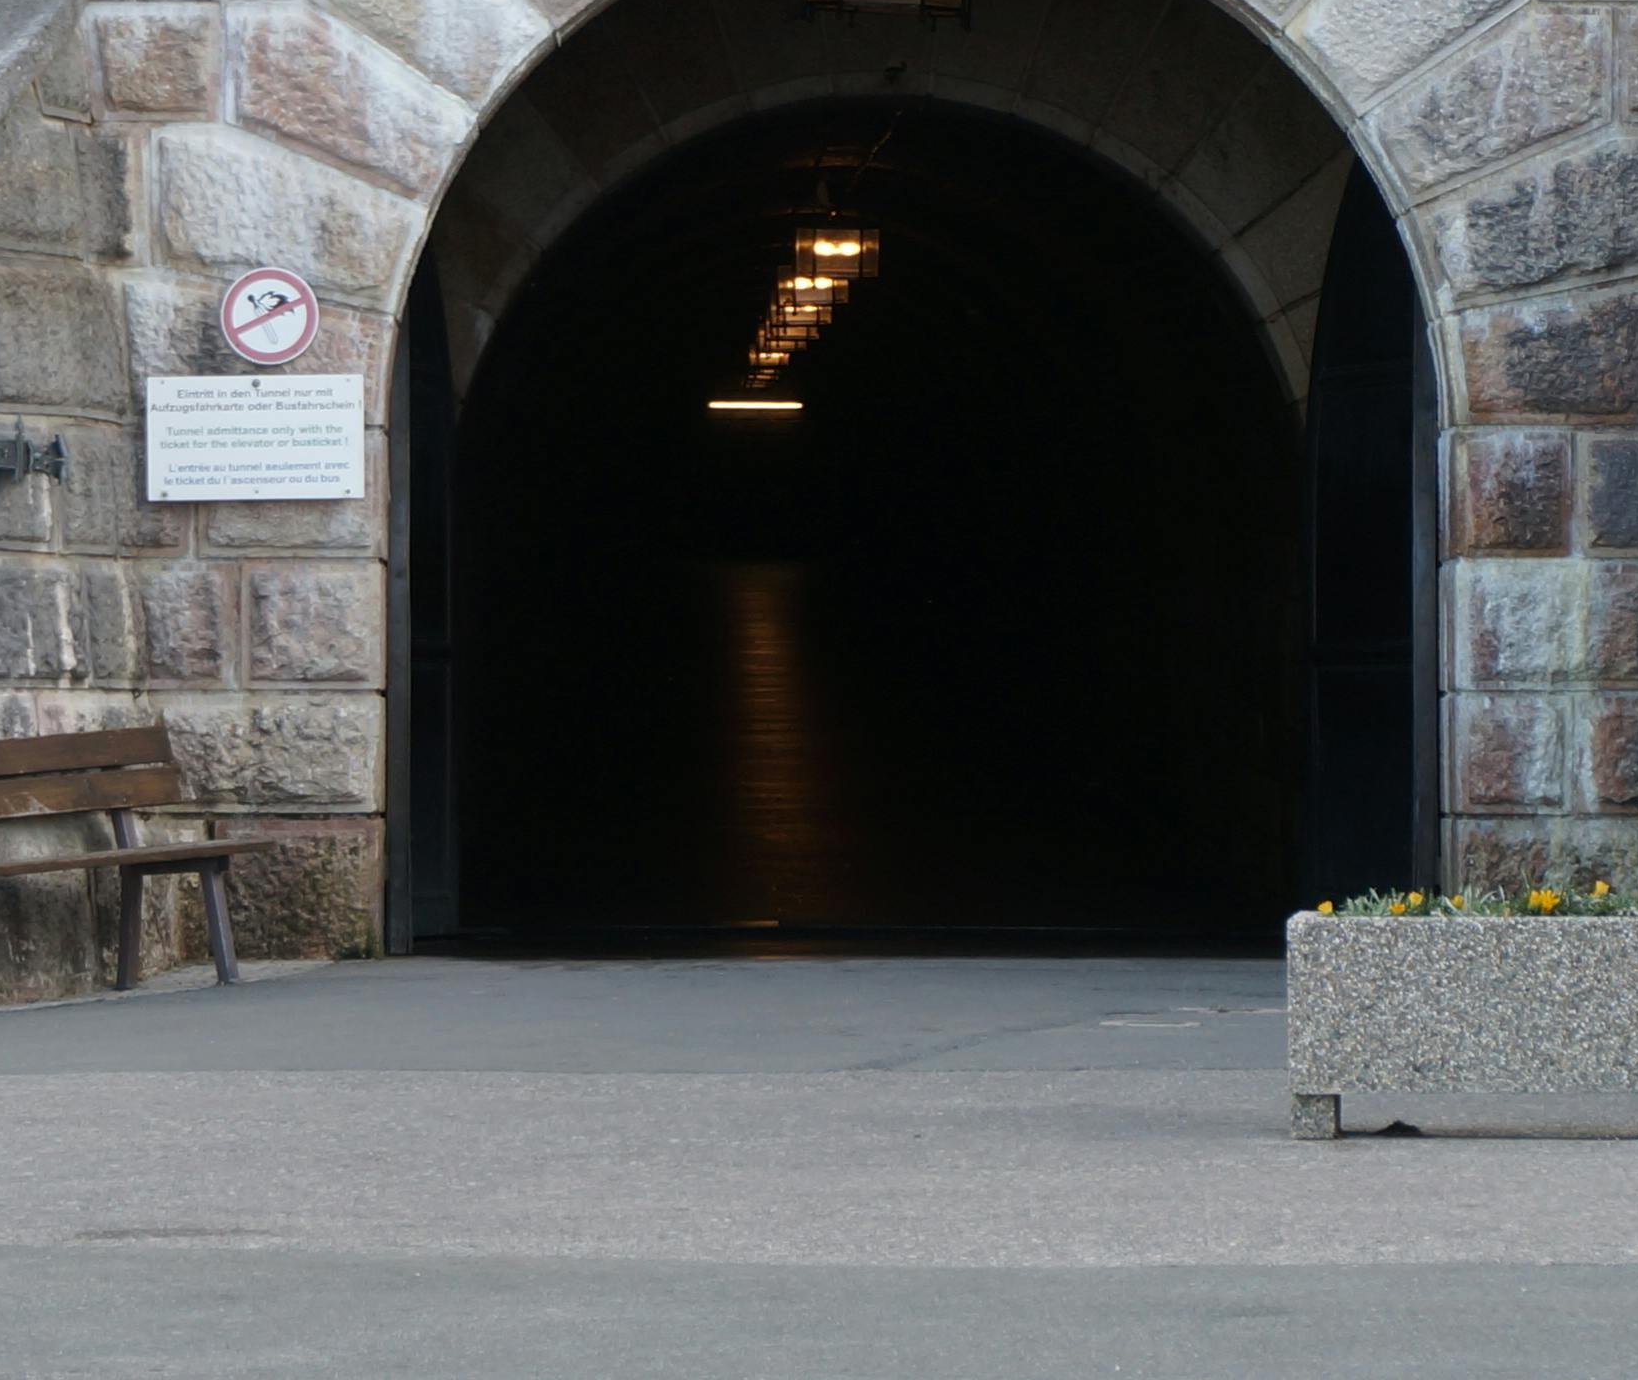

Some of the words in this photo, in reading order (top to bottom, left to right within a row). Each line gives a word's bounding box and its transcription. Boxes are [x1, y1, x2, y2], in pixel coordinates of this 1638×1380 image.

[177, 389, 214, 399] Eintritt
[217, 389, 227, 398] in
[230, 389, 251, 398] den
[255, 388, 291, 398] Tunnel
[294, 389, 312, 397] nur
[315, 388, 333, 397] mit
[247, 402, 273, 411] oder
[166, 426, 204, 436] Tunnel
[207, 425, 269, 435] admittance
[271, 425, 295, 437] only
[298, 424, 323, 434] with
[325, 424, 343, 434] the
[160, 439, 190, 449] ticket
[192, 439, 208, 448] for
[210, 438, 228, 448] the
[230, 438, 274, 448] elevator
[228, 462, 262, 472] tunnel
[265, 461, 321, 471] seulement
[175, 475, 205, 485] ticket
[207, 475, 221, 484] du
[305, 474, 319, 483] du
[320, 474, 340, 483] bus
